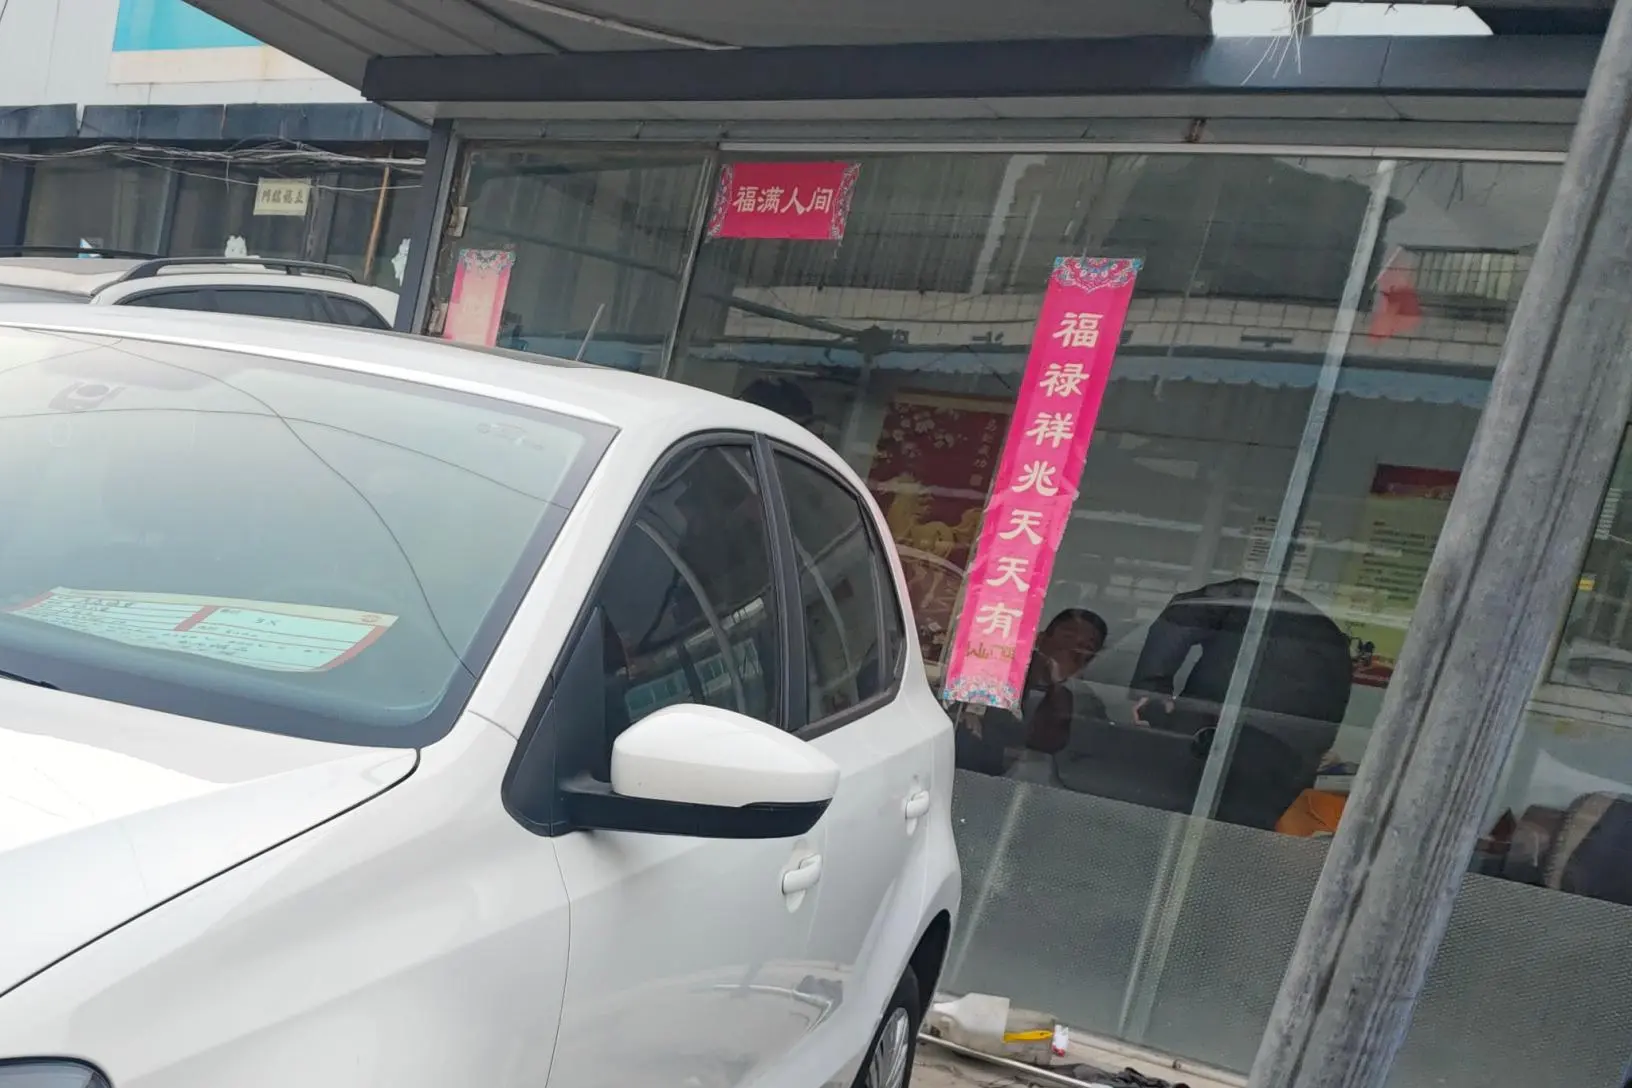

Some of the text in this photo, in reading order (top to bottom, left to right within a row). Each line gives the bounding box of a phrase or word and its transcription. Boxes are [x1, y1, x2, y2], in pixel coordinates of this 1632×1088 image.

[732, 185, 835, 216] 福满人间
[975, 311, 1104, 639] 福禄祥兆天天有
